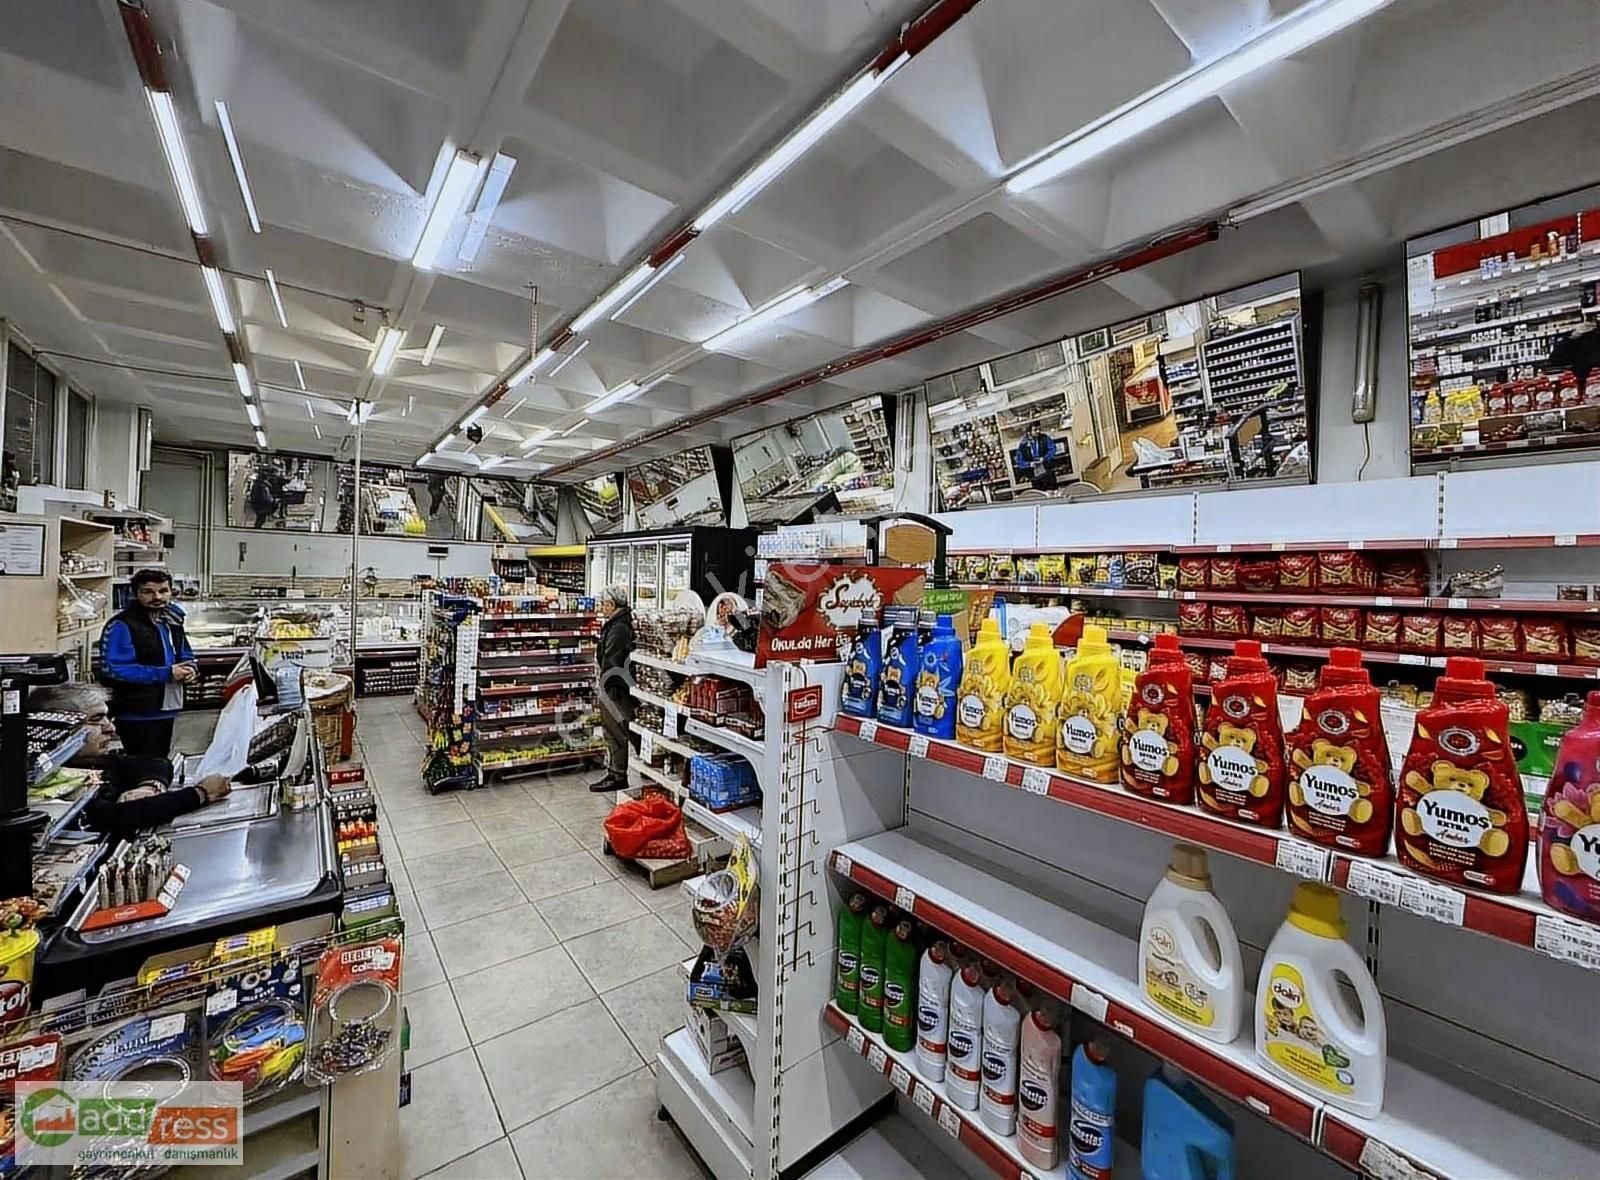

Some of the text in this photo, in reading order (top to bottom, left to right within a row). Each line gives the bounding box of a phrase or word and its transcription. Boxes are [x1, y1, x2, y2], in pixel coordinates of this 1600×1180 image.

[1133, 737, 1168, 757] Yumos
[1212, 754, 1257, 776] Yumos
[1304, 773, 1358, 799] Yumos
[1423, 798, 1490, 829] Yumos
[1437, 820, 1471, 833] EXTRA
[1273, 983, 1301, 1004] dalin
